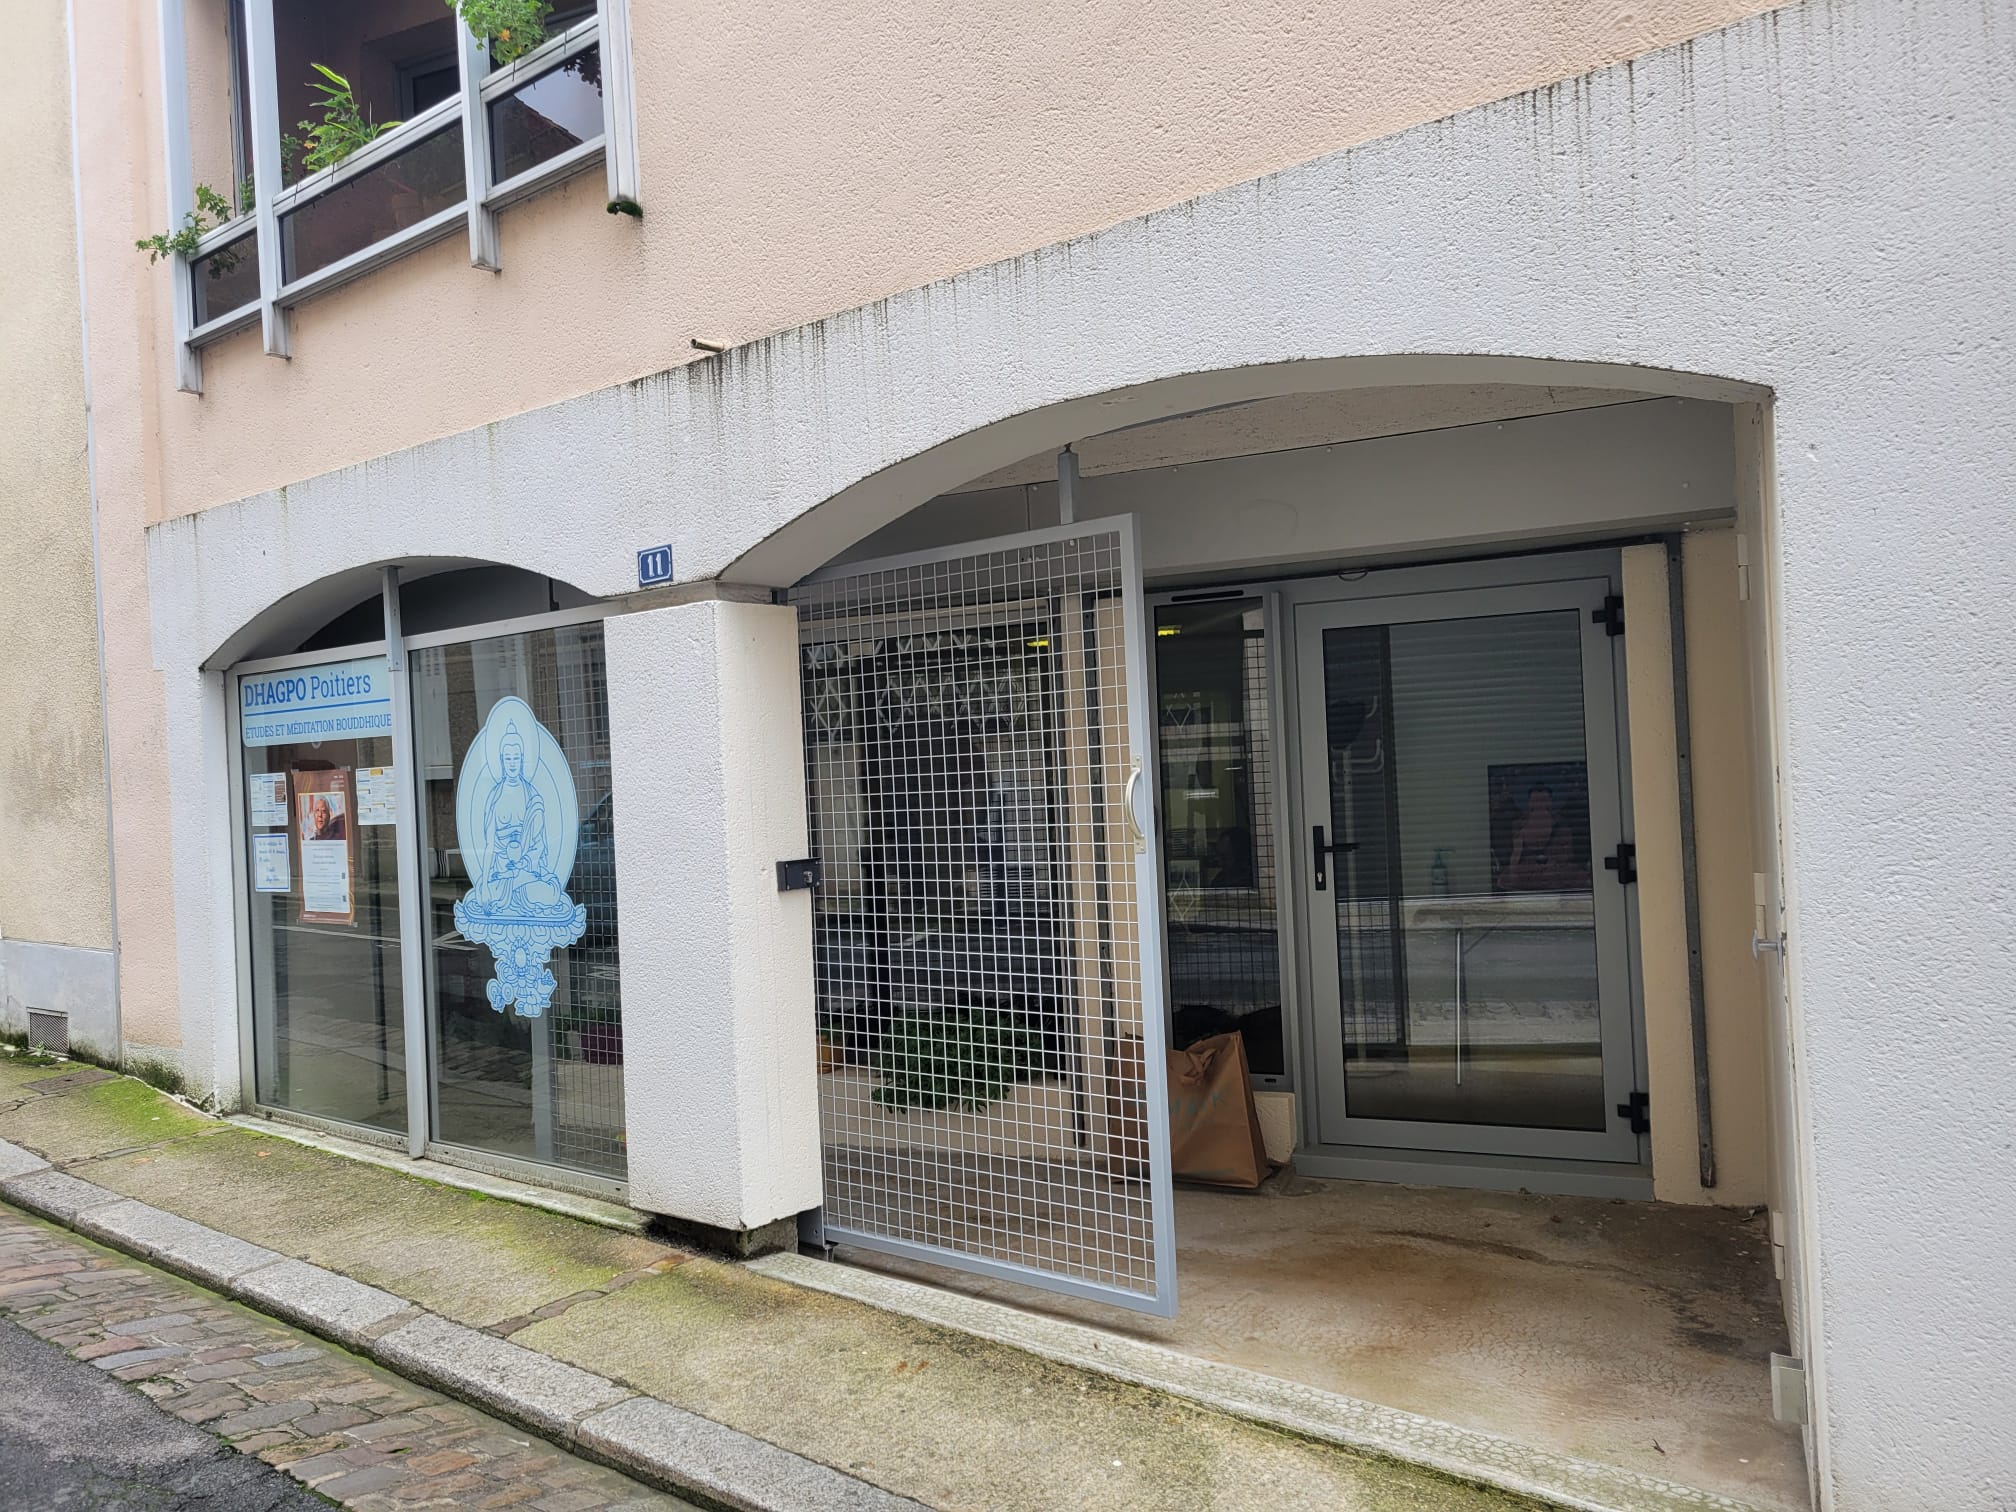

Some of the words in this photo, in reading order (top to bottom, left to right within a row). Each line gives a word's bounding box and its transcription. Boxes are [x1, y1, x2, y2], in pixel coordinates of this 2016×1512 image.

[648, 552, 663, 577] 11
[244, 677, 307, 707] DHAGPO
[310, 671, 371, 700] Poitiers
[275, 724, 285, 737] ET
